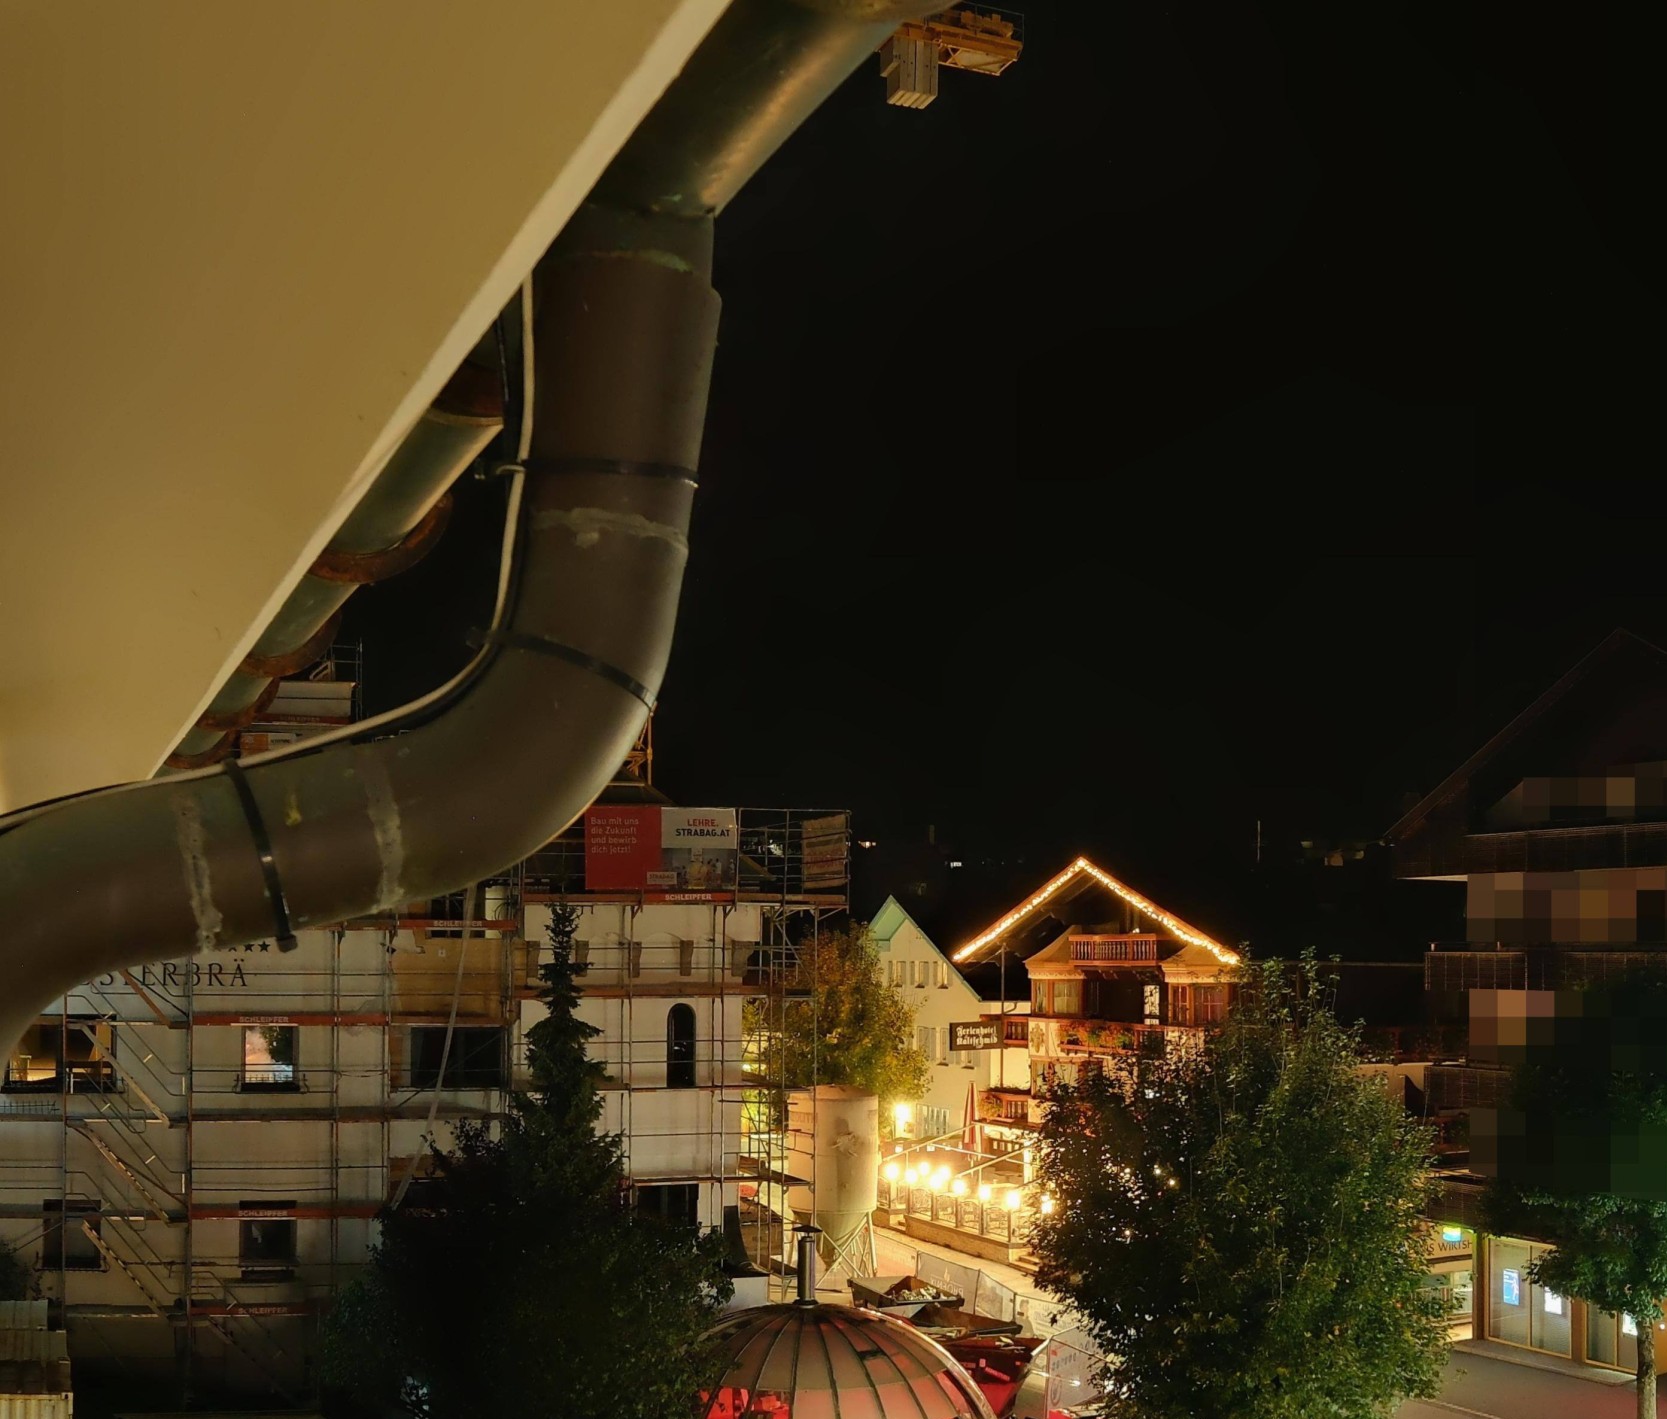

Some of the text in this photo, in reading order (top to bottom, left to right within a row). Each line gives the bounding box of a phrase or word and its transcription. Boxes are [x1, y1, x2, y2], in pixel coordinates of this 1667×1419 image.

[590, 817, 607, 825] Bau
[608, 817, 622, 825] mit
[687, 819, 719, 827] LEHRE.
[605, 827, 636, 835] Zukunft
[675, 829, 730, 837] STRABAG.AT
[591, 836, 637, 844] und bewirb
